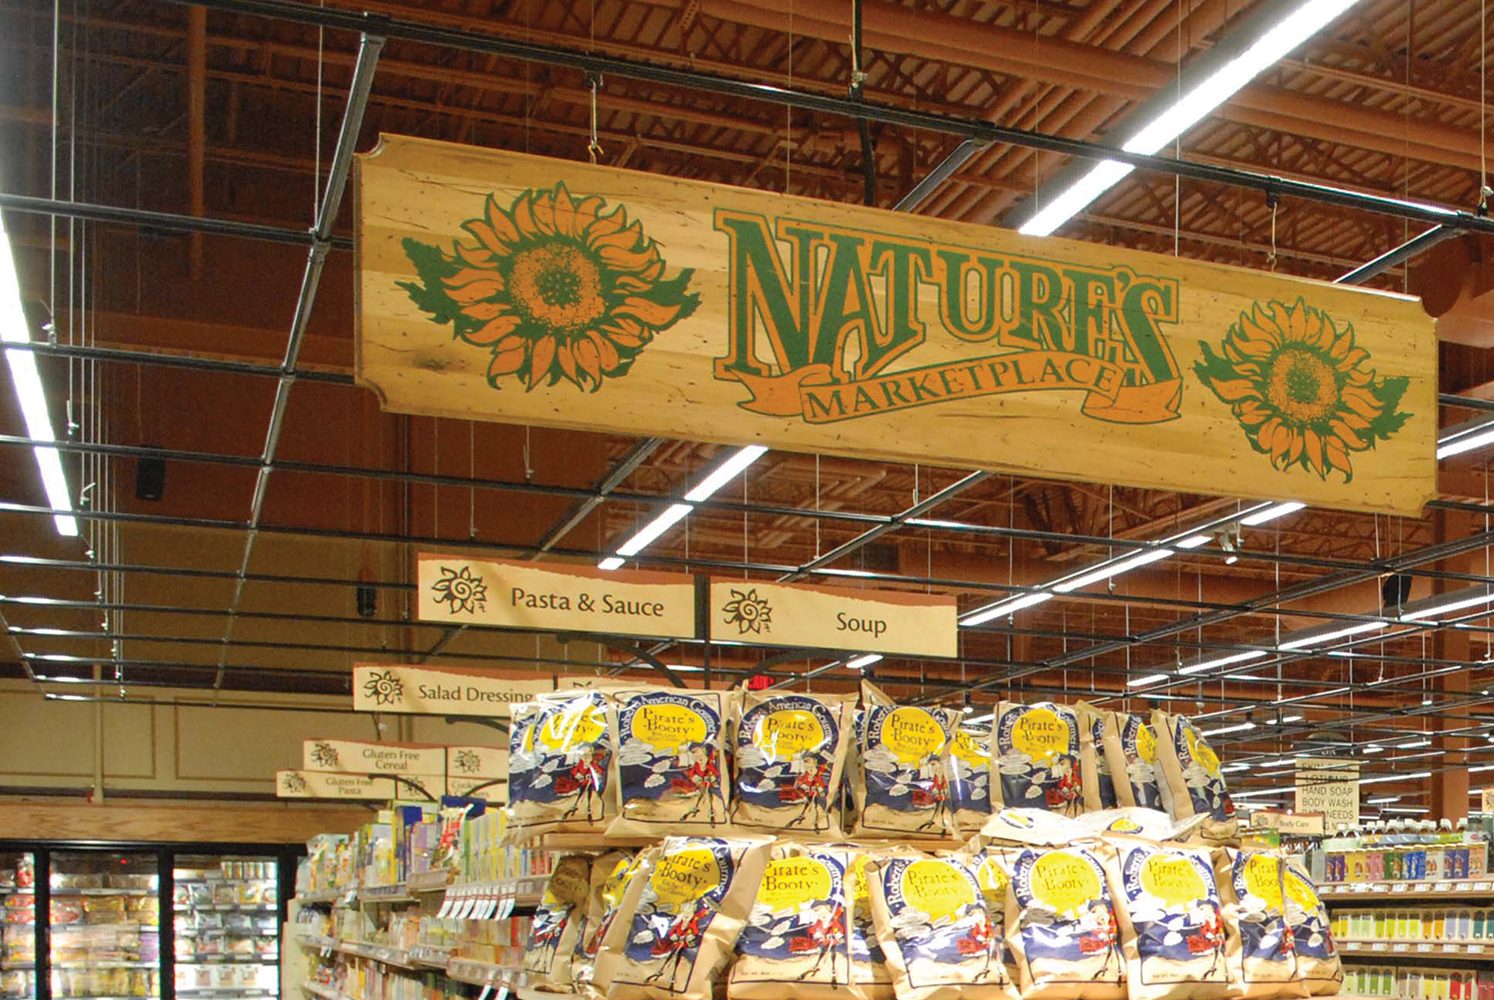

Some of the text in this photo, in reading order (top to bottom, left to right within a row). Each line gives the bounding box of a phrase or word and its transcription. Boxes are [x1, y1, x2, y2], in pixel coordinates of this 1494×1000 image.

[714, 208, 1180, 387] NATURE'S
[806, 356, 1118, 419] MARKETPLACE
[512, 588, 663, 616] Pasta & Sauce
[837, 612, 886, 637] Soup
[418, 683, 532, 705] Salad Dressing
[641, 693, 688, 709] American
[643, 707, 695, 725] Pirate's
[891, 714, 934, 734] Pirate's
[1020, 716, 1062, 732] Pirate's
[646, 723, 691, 735] Booty
[892, 729, 931, 747] Booty
[363, 749, 419, 760] Gluten Free
[376, 760, 407, 769] Cereal
[1302, 787, 1352, 795] HAND SOAP
[1302, 798, 1352, 807] BODY WASH
[661, 865, 702, 887] Booty
[766, 876, 812, 891] Booty
